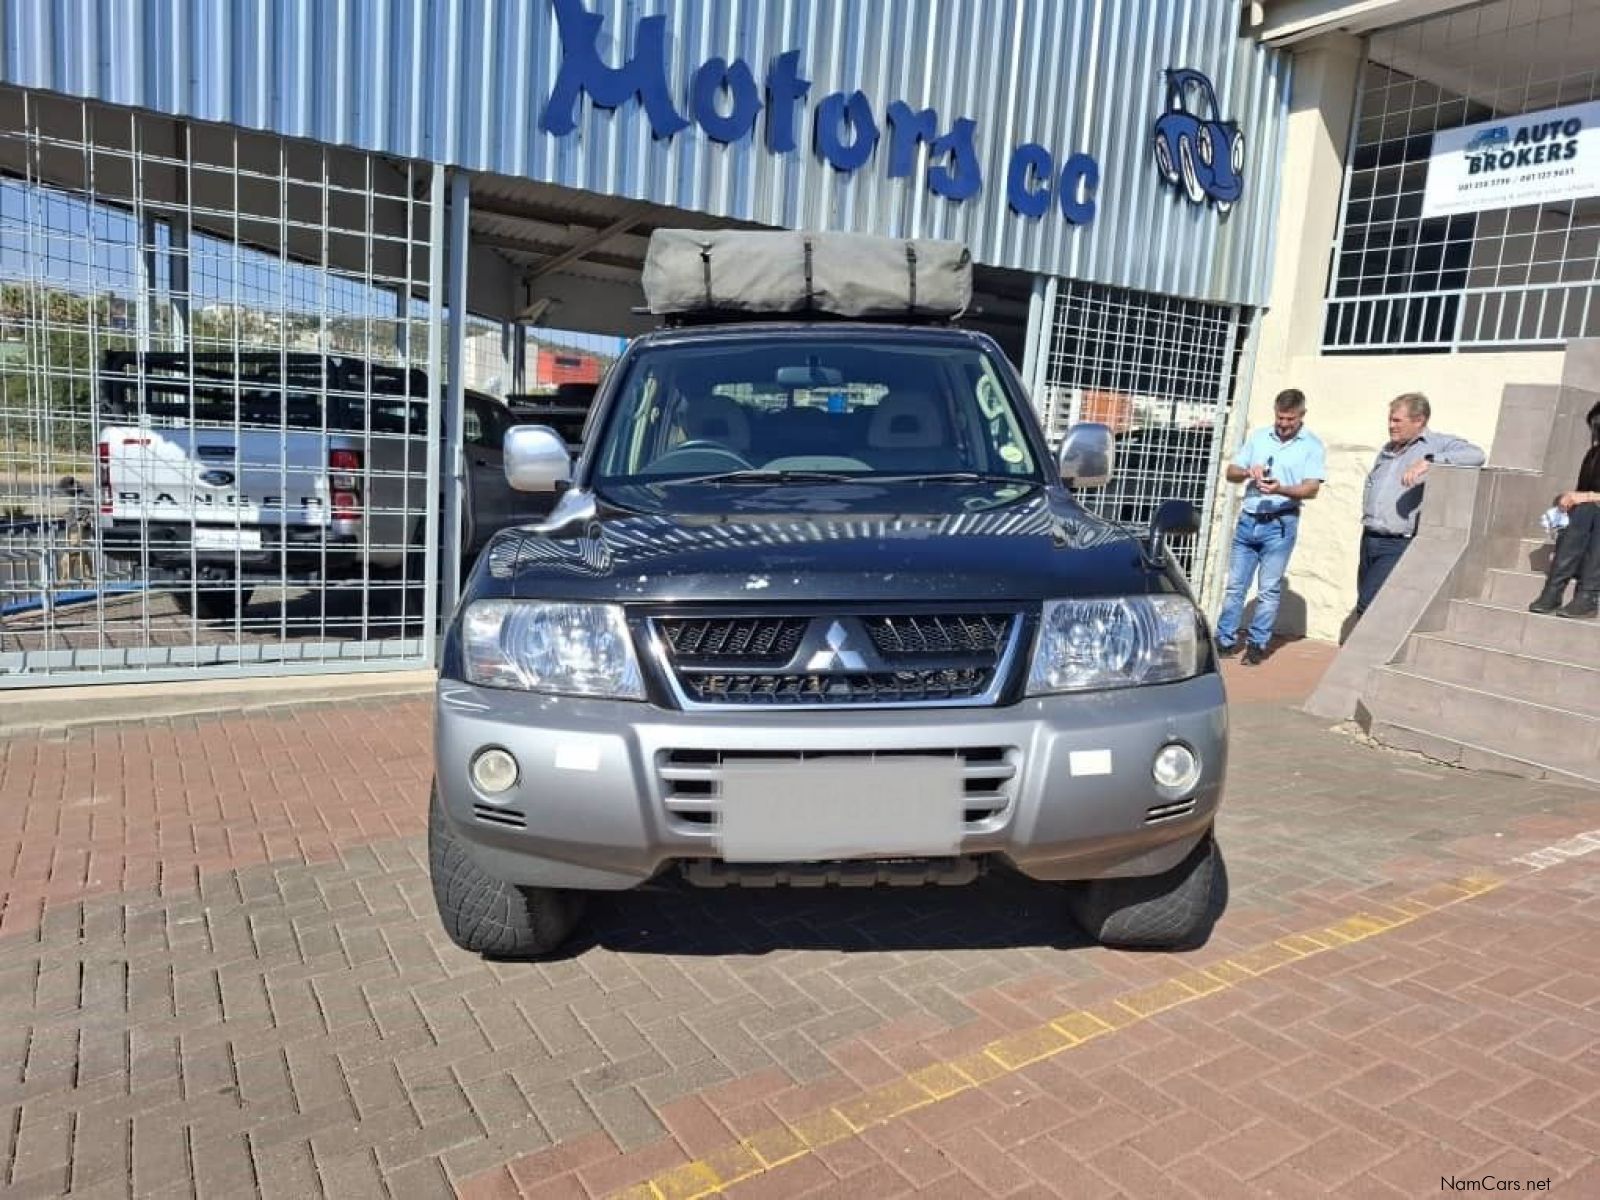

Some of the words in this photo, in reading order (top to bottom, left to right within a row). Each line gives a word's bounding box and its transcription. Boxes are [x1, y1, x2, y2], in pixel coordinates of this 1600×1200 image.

[538, 0, 983, 201] Motors
[1006, 143, 1099, 226] cc
[1514, 117, 1582, 147] AUTO
[1466, 140, 1579, 175] BROKERS
[118, 491, 324, 507] RANGER
